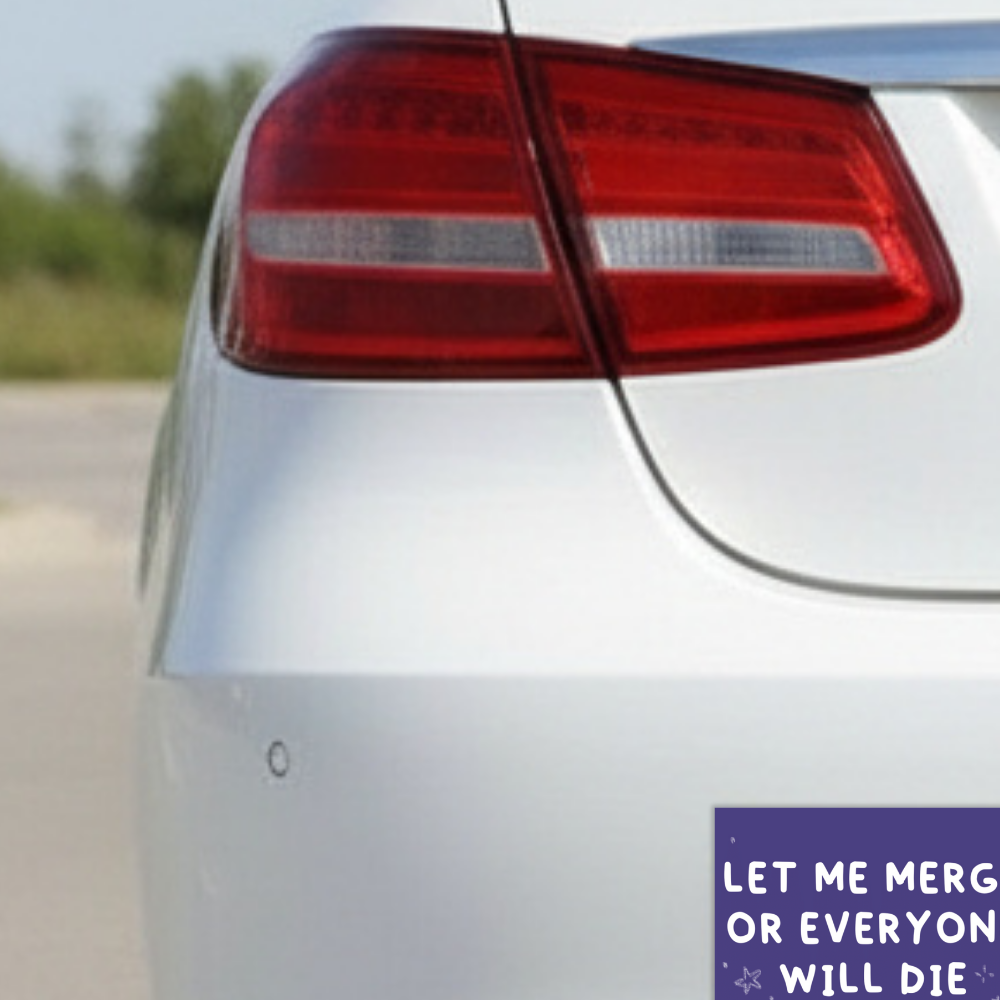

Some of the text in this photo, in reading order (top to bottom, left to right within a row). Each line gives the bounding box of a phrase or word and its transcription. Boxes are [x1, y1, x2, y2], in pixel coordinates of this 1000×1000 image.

[723, 861, 797, 895] LET
[815, 860, 868, 895] ME
[726, 911, 783, 945] OR
[779, 961, 967, 997] WILL DIE
